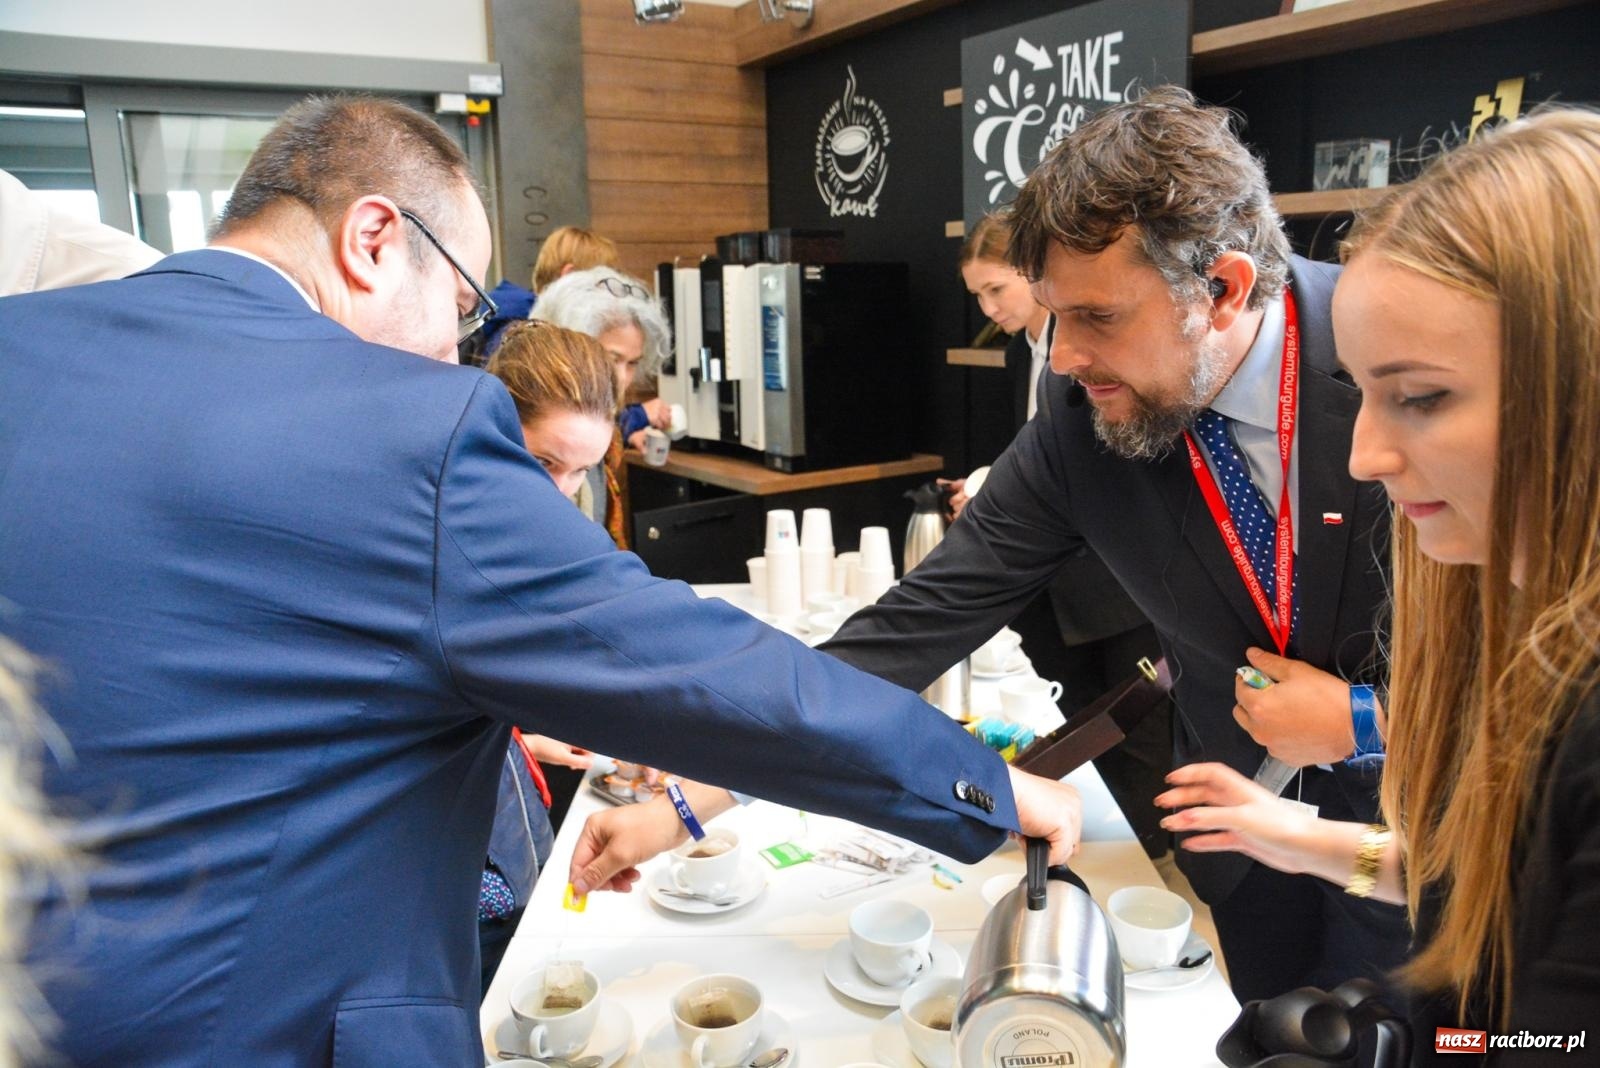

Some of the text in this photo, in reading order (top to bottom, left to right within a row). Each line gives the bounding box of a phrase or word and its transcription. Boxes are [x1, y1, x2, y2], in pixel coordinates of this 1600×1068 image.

[1057, 31, 1123, 102] TAKE
[973, 104, 1085, 188] Coff
[1280, 325, 1296, 460] systemtourguide.com
[1278, 516, 1291, 626] systemtourguide.com
[1013, 1028, 1050, 1039] POLAND
